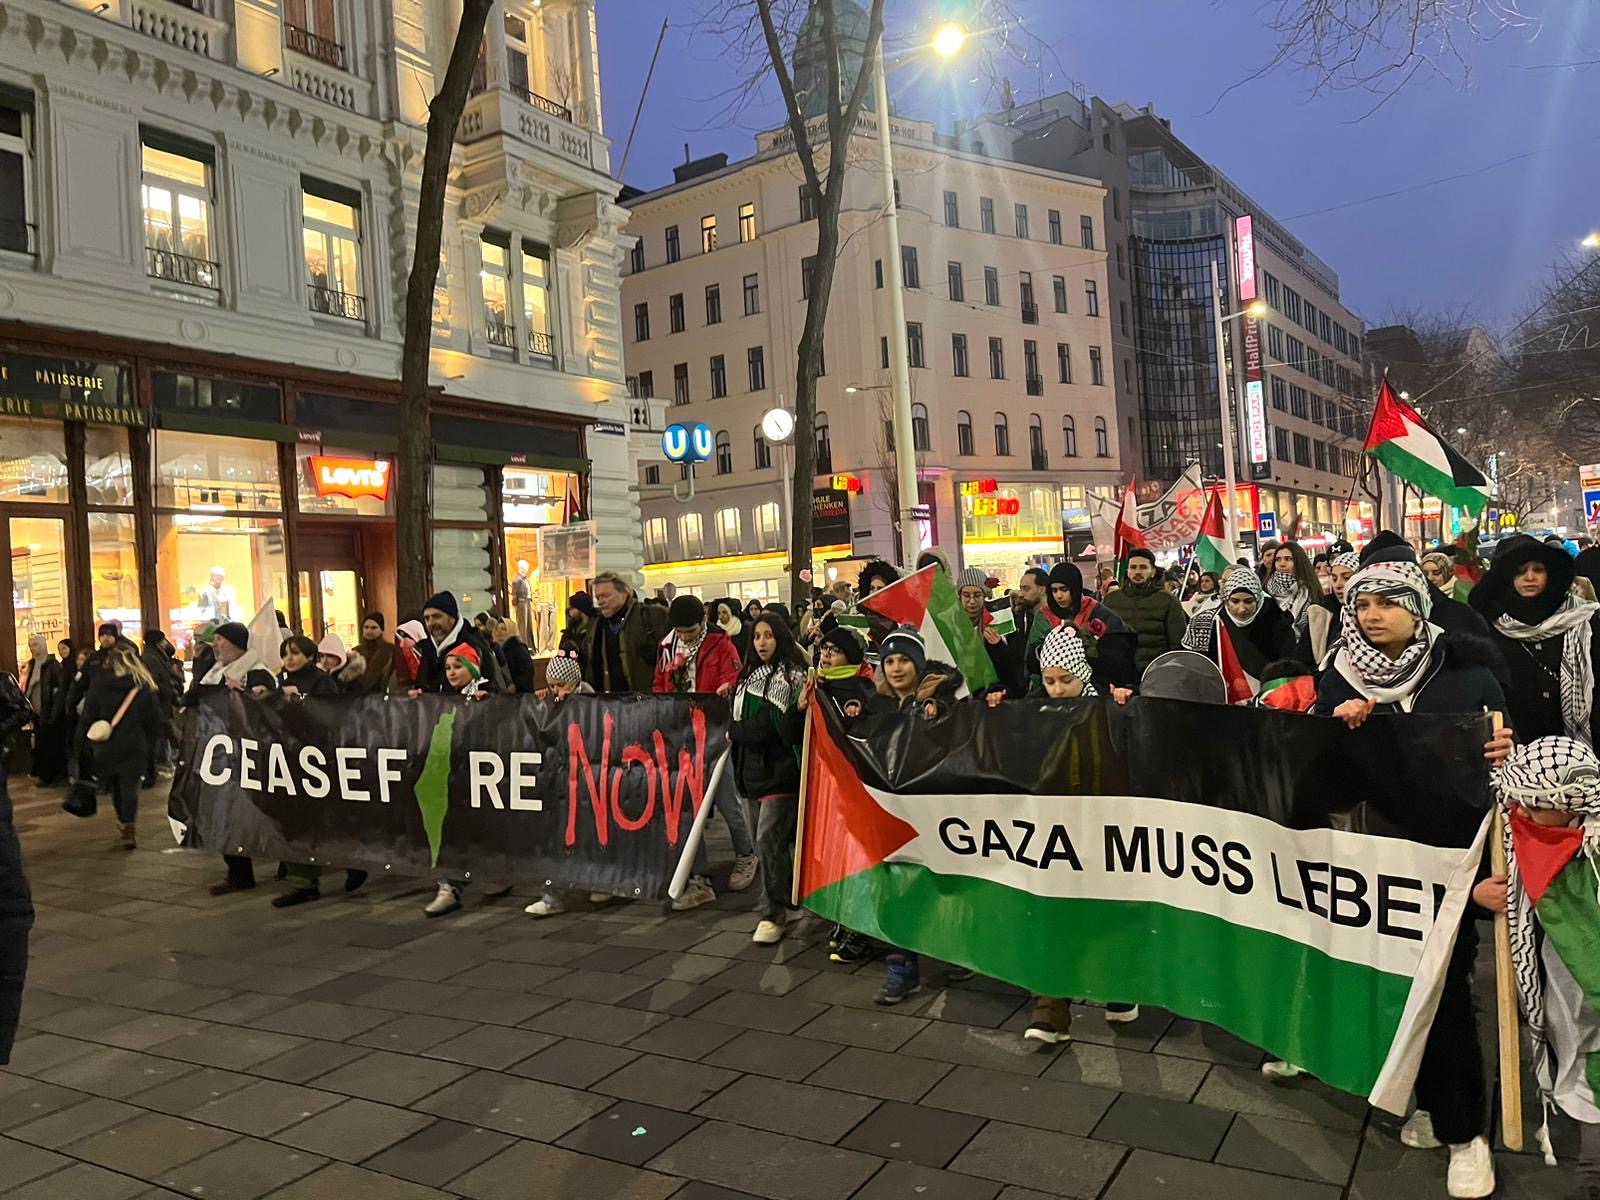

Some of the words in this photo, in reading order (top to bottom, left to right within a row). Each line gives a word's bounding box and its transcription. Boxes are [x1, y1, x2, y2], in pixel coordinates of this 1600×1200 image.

[665, 430, 687, 457] U
[695, 428, 711, 456] U
[811, 501, 845, 512] HENKEN
[812, 494, 831, 504] HULE
[938, 816, 1084, 872] GAZA
[1103, 824, 1254, 896] MUSS
